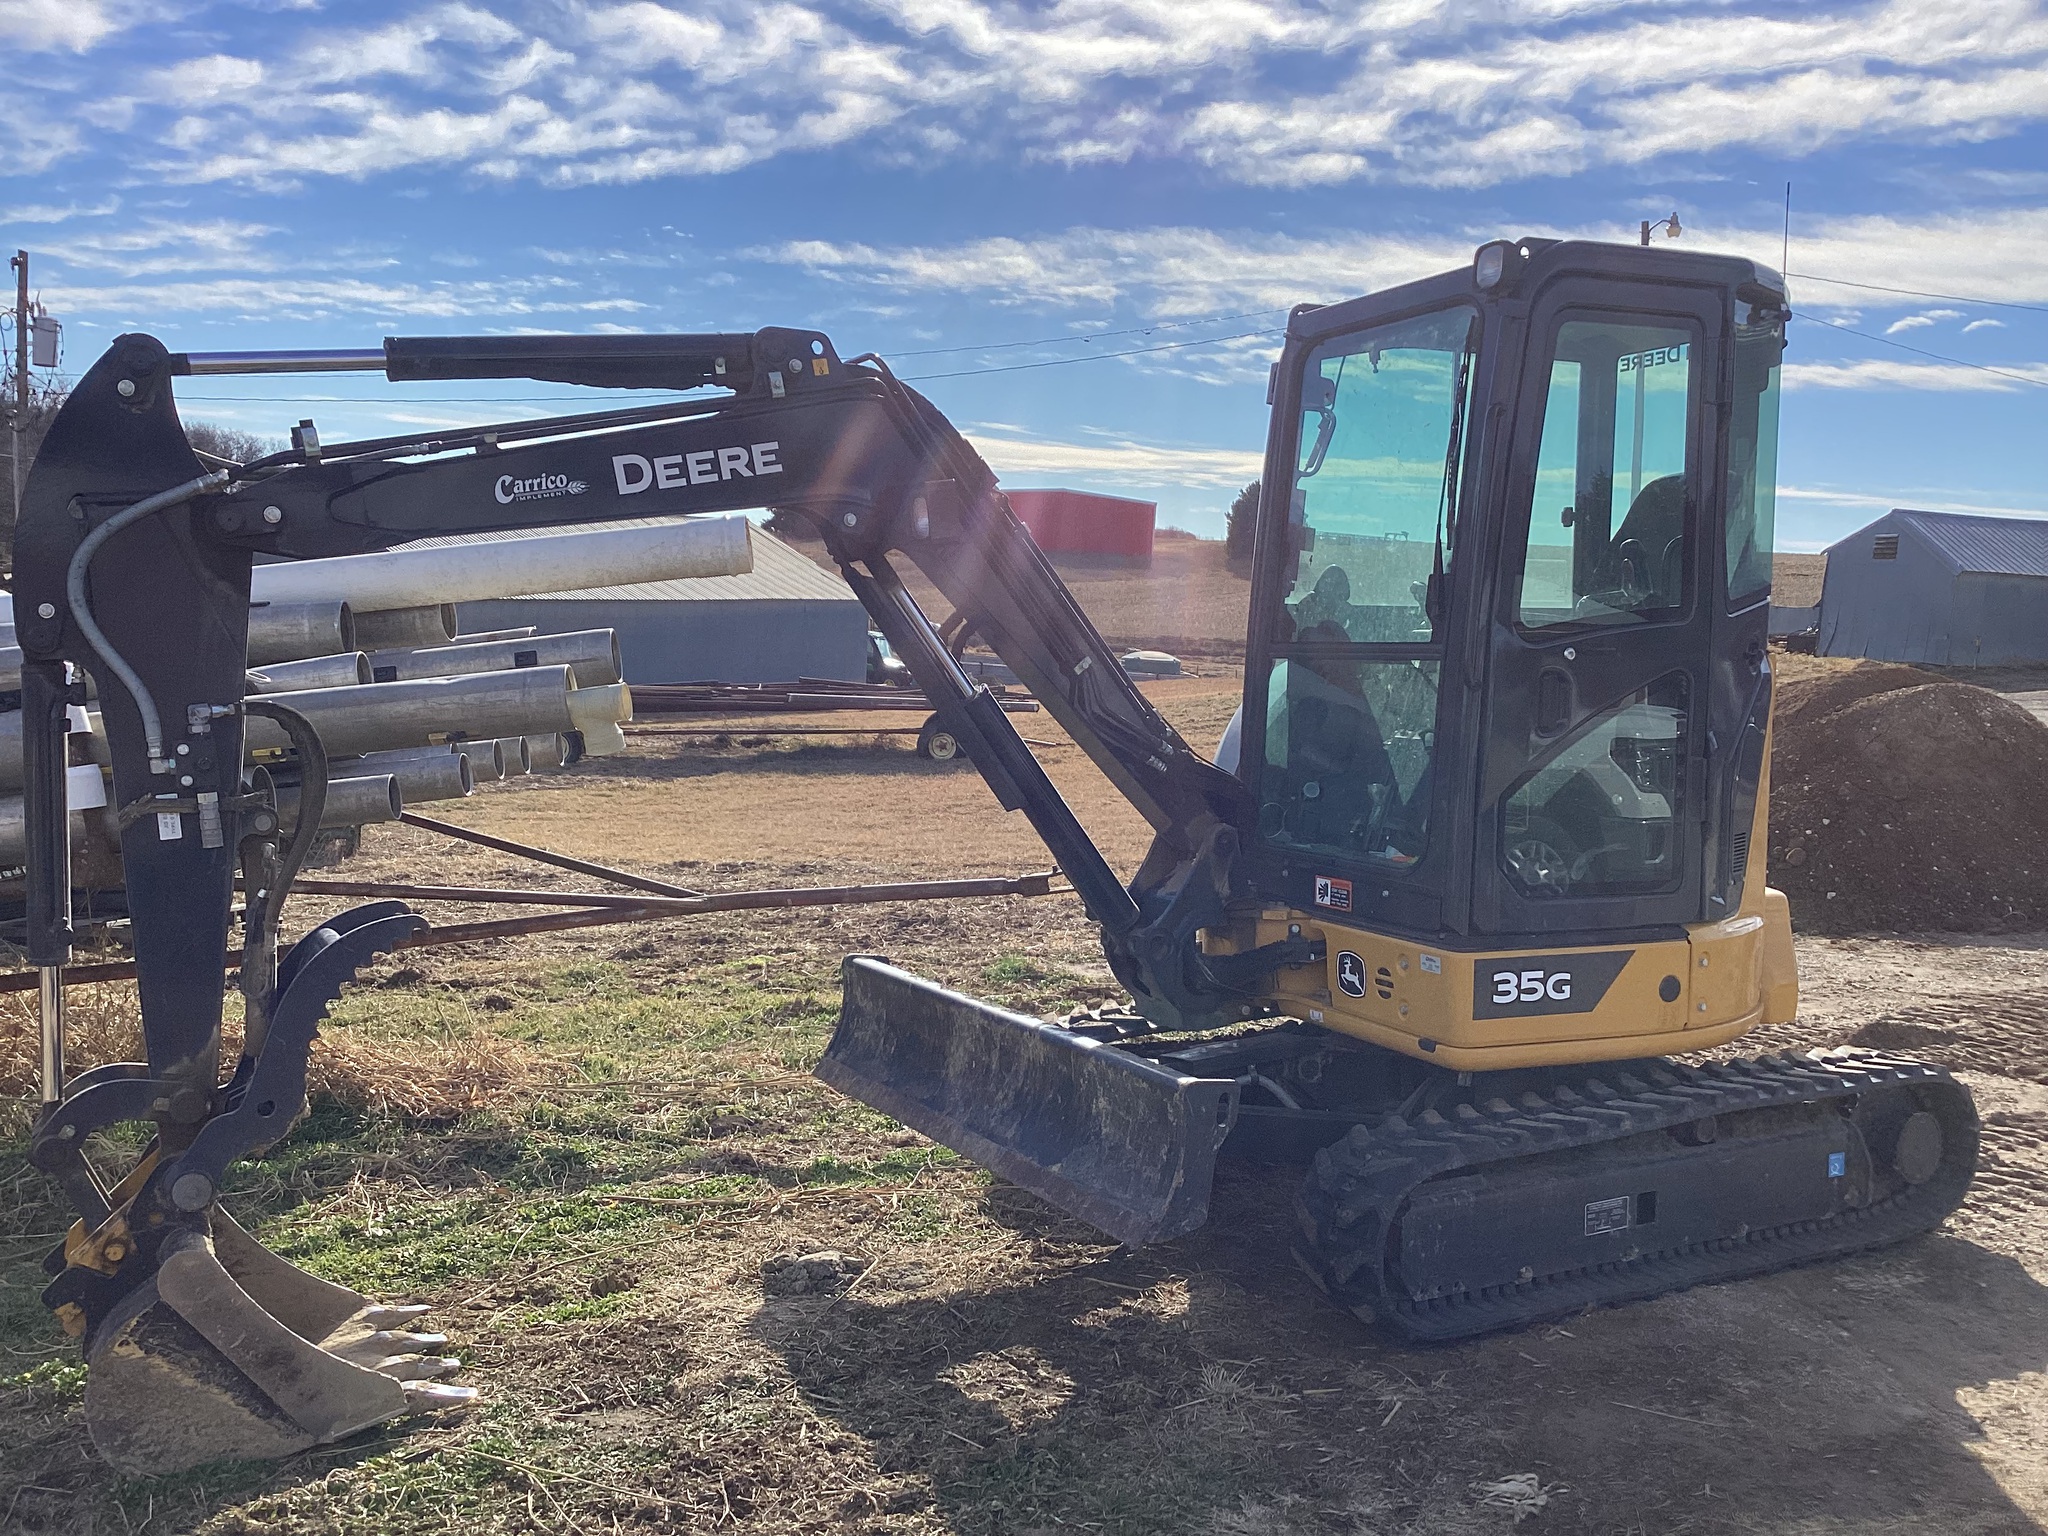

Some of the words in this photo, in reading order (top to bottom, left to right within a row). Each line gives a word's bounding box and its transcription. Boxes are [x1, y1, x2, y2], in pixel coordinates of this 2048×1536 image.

[612, 441, 783, 495] DEERE
[495, 473, 567, 504] Carrico
[516, 490, 567, 502] IMPLEMENT
[1493, 971, 1571, 1004] 35G
